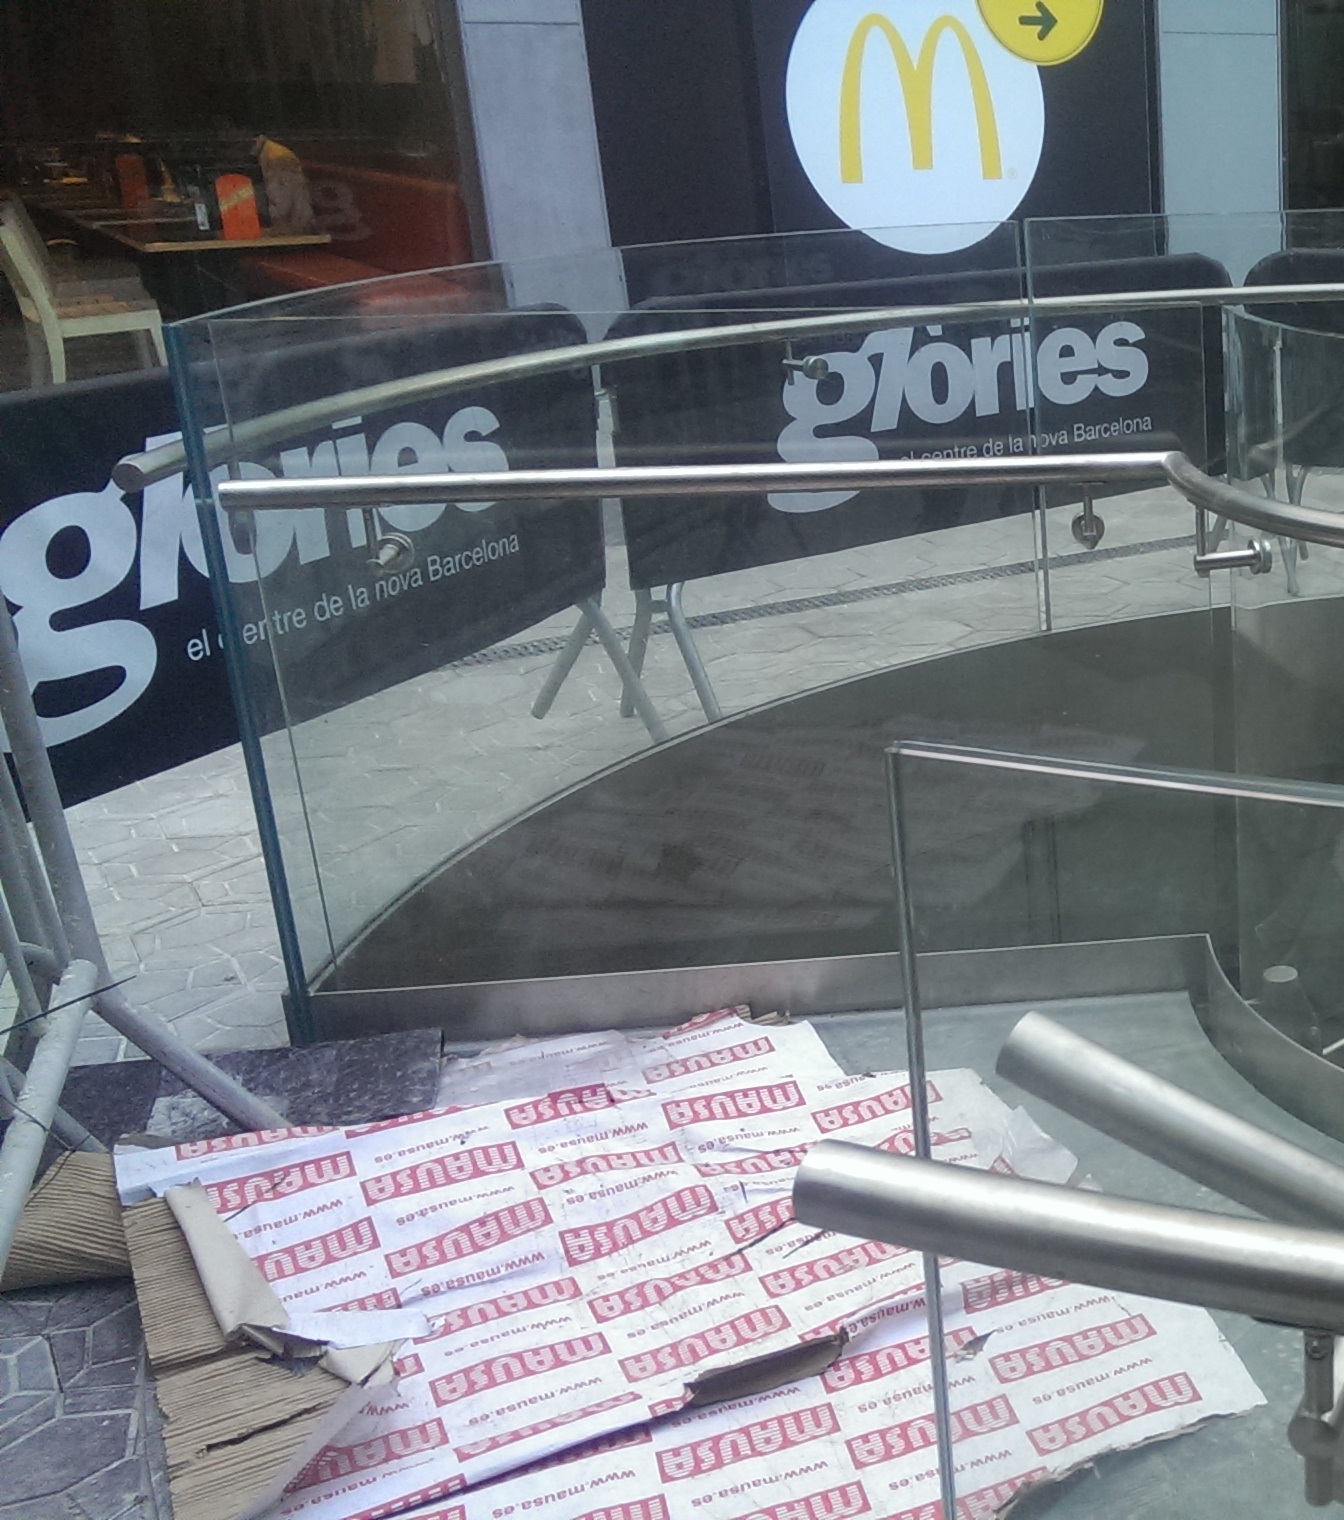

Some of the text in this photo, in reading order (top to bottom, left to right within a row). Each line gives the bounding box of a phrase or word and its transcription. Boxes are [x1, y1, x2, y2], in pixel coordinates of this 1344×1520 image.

[983, 437, 1004, 457] de
[1009, 435, 1024, 454] la
[1073, 415, 1152, 443] Barcelona
[187, 629, 211, 661] el
[314, 593, 344, 622] de
[348, 584, 370, 610] la
[375, 568, 424, 601] nova
[427, 534, 520, 582] Barcelona
[645, 1038, 772, 1082] MAUSA
[665, 1082, 800, 1125] MAUSA
[538, 1121, 648, 1154] www.mausa.es
[698, 1127, 801, 1154] www.mausa.es
[364, 1143, 520, 1202] MAUSA
[533, 1144, 678, 1188] MAUSA
[566, 1168, 679, 1205] www.mausa.es
[396, 1184, 516, 1227] www.mausa.es
[563, 1185, 713, 1262] MAUSA
[261, 1220, 375, 1279] MAU
[389, 1199, 548, 1274] MAUSA
[596, 1239, 712, 1280] www.mausa.es
[420, 1251, 545, 1297] www.mausa.es
[803, 1261, 917, 1312] www.mausa.es
[428, 1278, 577, 1340] MAUS
[627, 1291, 745, 1339] www.mausa.es
[995, 1294, 1111, 1335] www.mausa.es
[444, 1315, 572, 1356] www.mausa.es
[621, 1306, 785, 1379] MAUSA
[992, 1315, 1151, 1381] MAUSA
[434, 1334, 606, 1404] MAUSA
[1032, 1356, 1153, 1406] www.mausa.es
[467, 1376, 603, 1427] www.mausa.es
[857, 1375, 976, 1414] wwmausa.es
[1030, 1373, 1196, 1453] MAUSA
[317, 1420, 443, 1483] MAU
[661, 1405, 834, 1479] MAUSA
[492, 1469, 636, 1519] www.mausa.es
[691, 1460, 829, 1508] www.mausa.es
